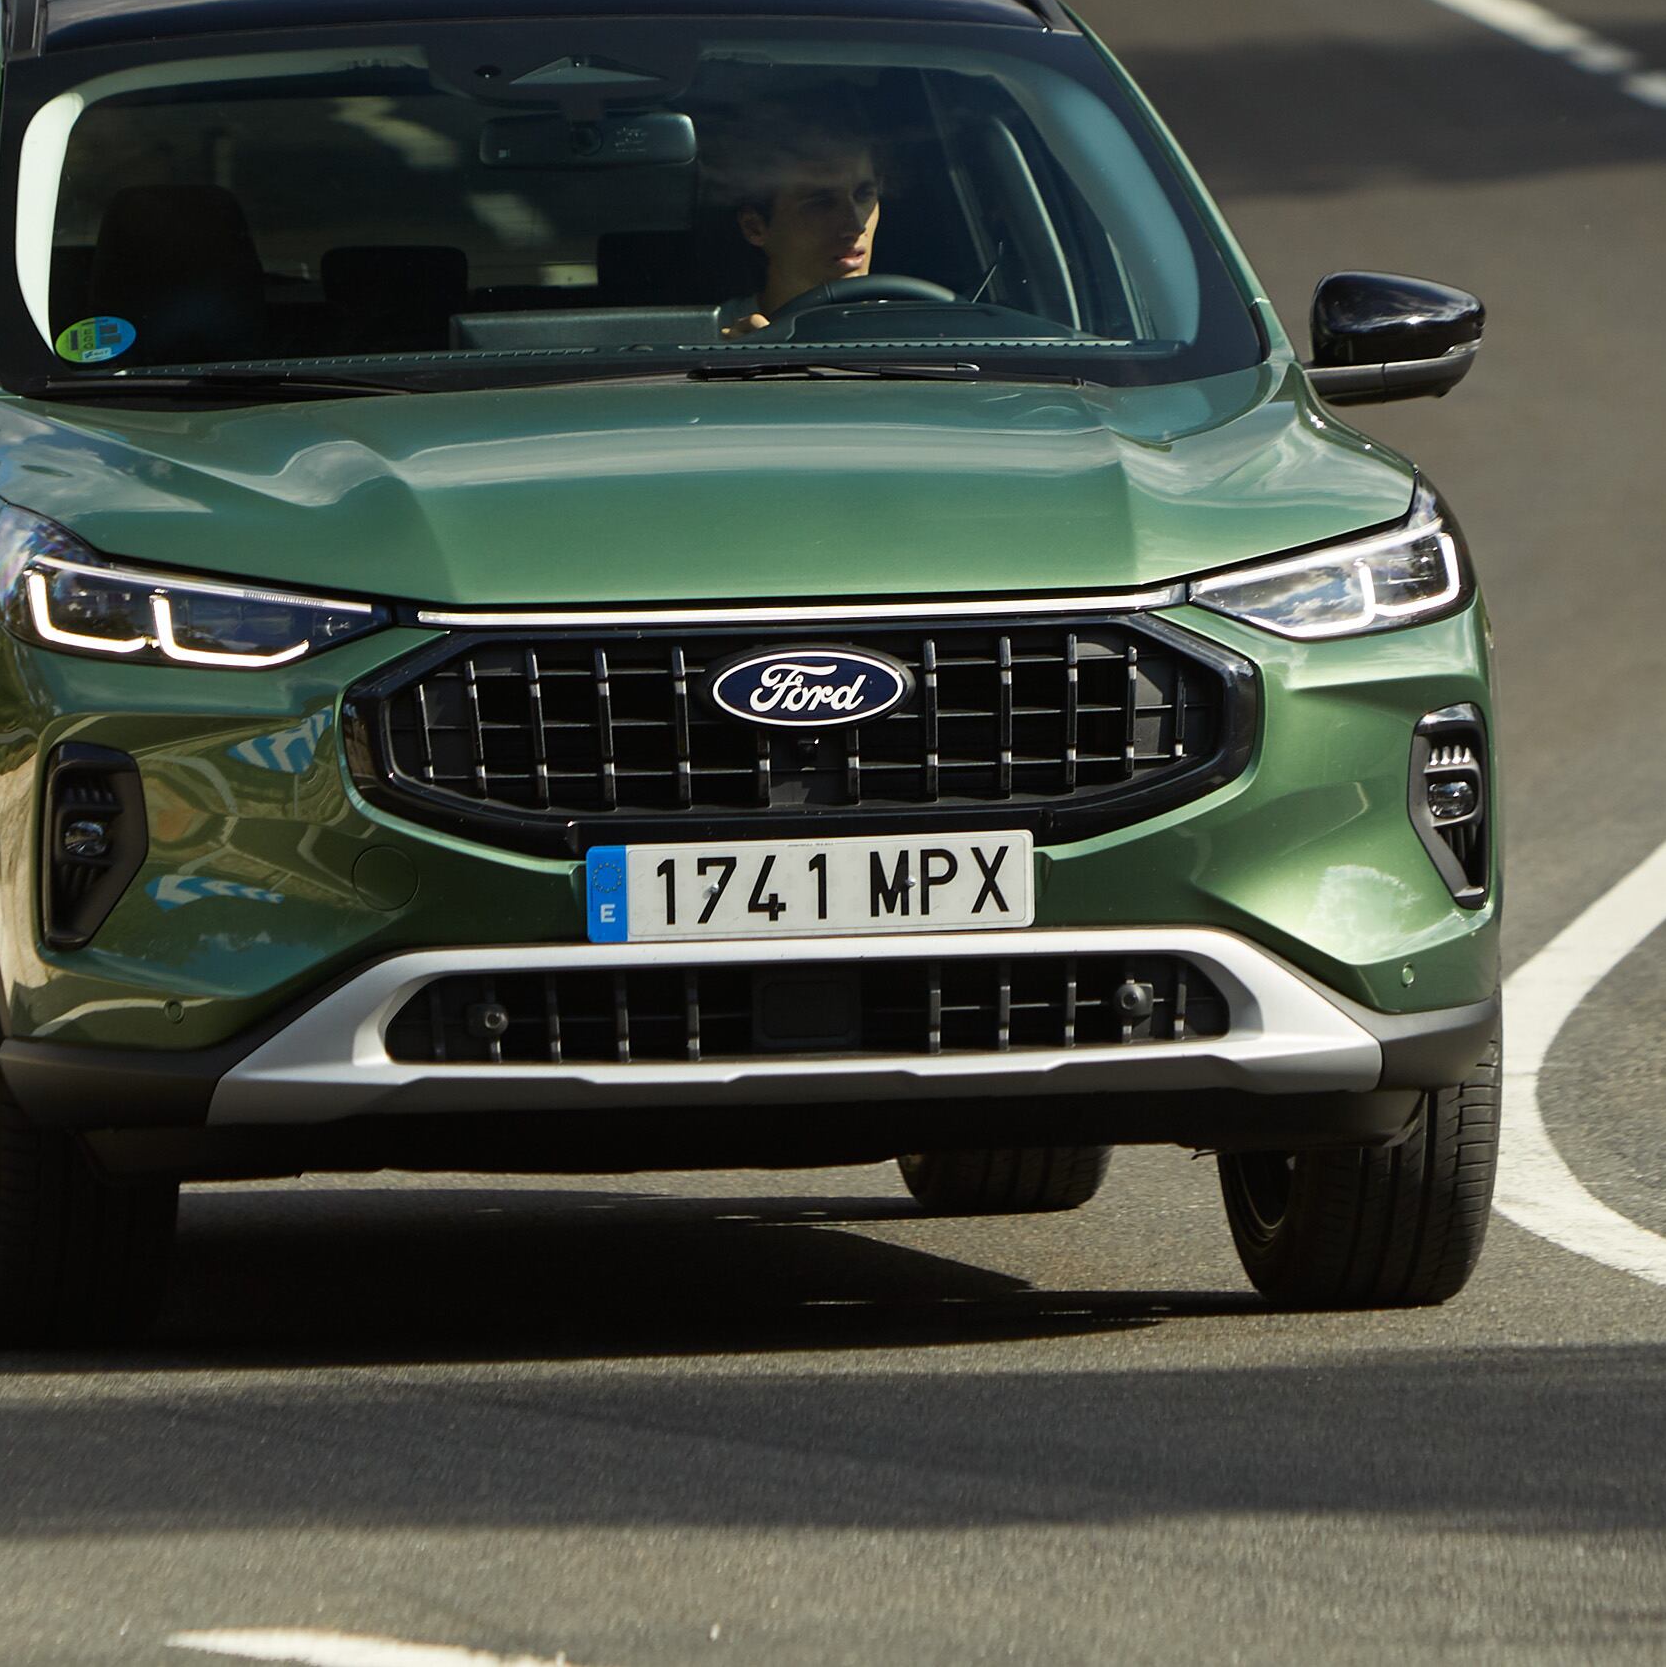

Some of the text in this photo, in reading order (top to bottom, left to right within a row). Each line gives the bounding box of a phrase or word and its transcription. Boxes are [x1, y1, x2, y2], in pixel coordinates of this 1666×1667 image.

[750, 664, 864, 712] Ford
[657, 846, 1009, 925] 1741 MPX
[600, 904, 615, 923] E
